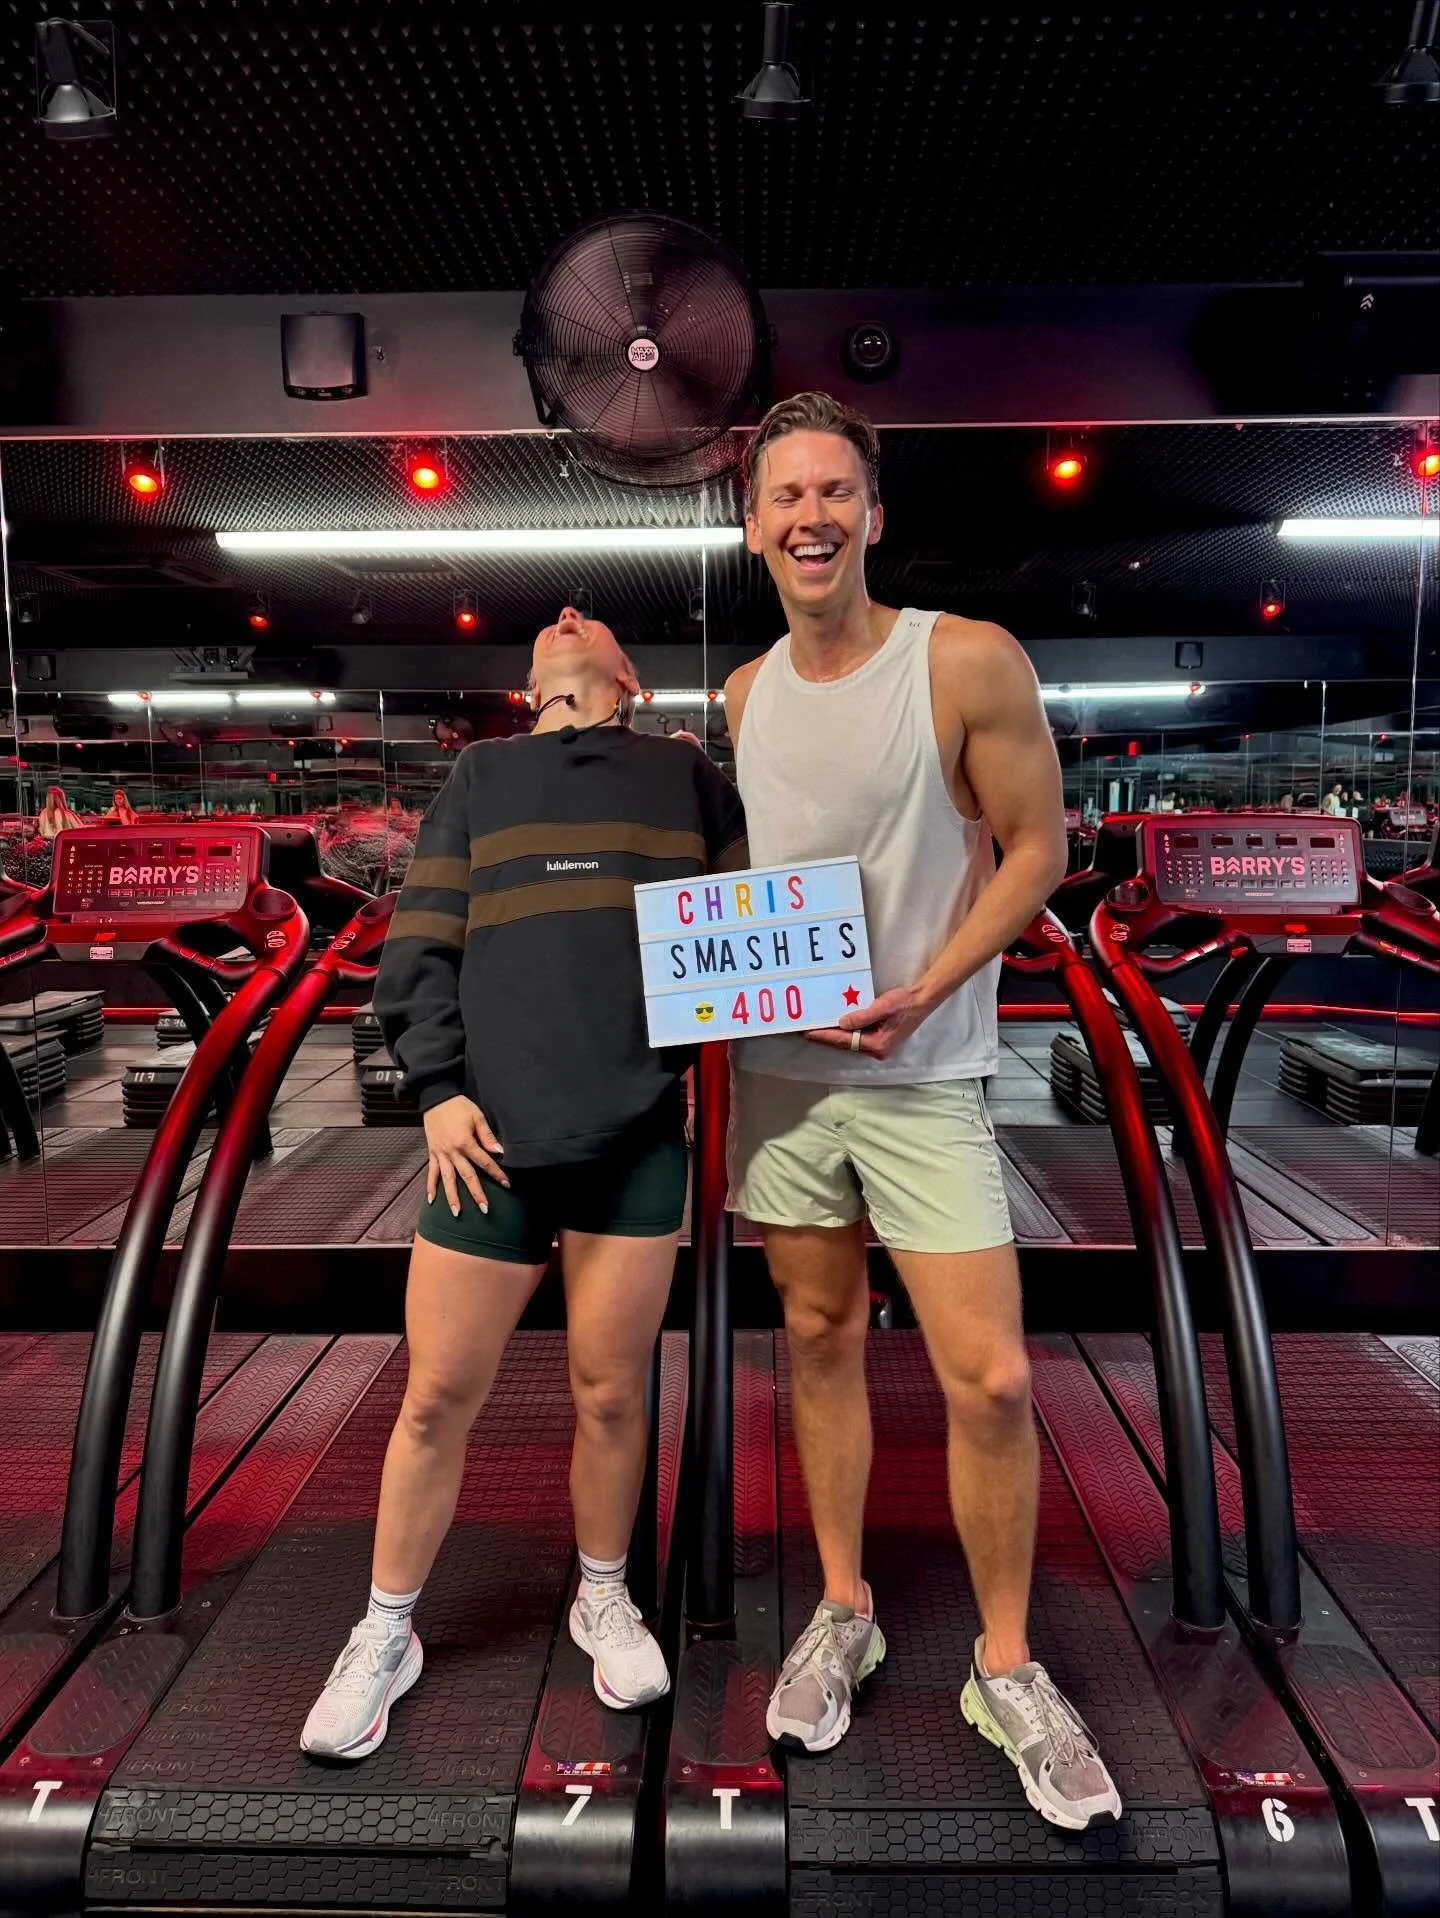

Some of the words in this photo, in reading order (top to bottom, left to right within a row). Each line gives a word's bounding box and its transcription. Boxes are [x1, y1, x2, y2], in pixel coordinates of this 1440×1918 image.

[546, 859, 599, 871] lululemon
[677, 875, 805, 925] CHRIS
[670, 922, 856, 979] SMASHES
[731, 984, 803, 1025] 400
[28, 1780, 62, 1823] T
[428, 1811, 507, 1829] 4FRONT
[561, 1784, 593, 1826] 7
[711, 1787, 741, 1830] T
[1262, 1797, 1295, 1842] 6
[1404, 1796, 1440, 1842] T
